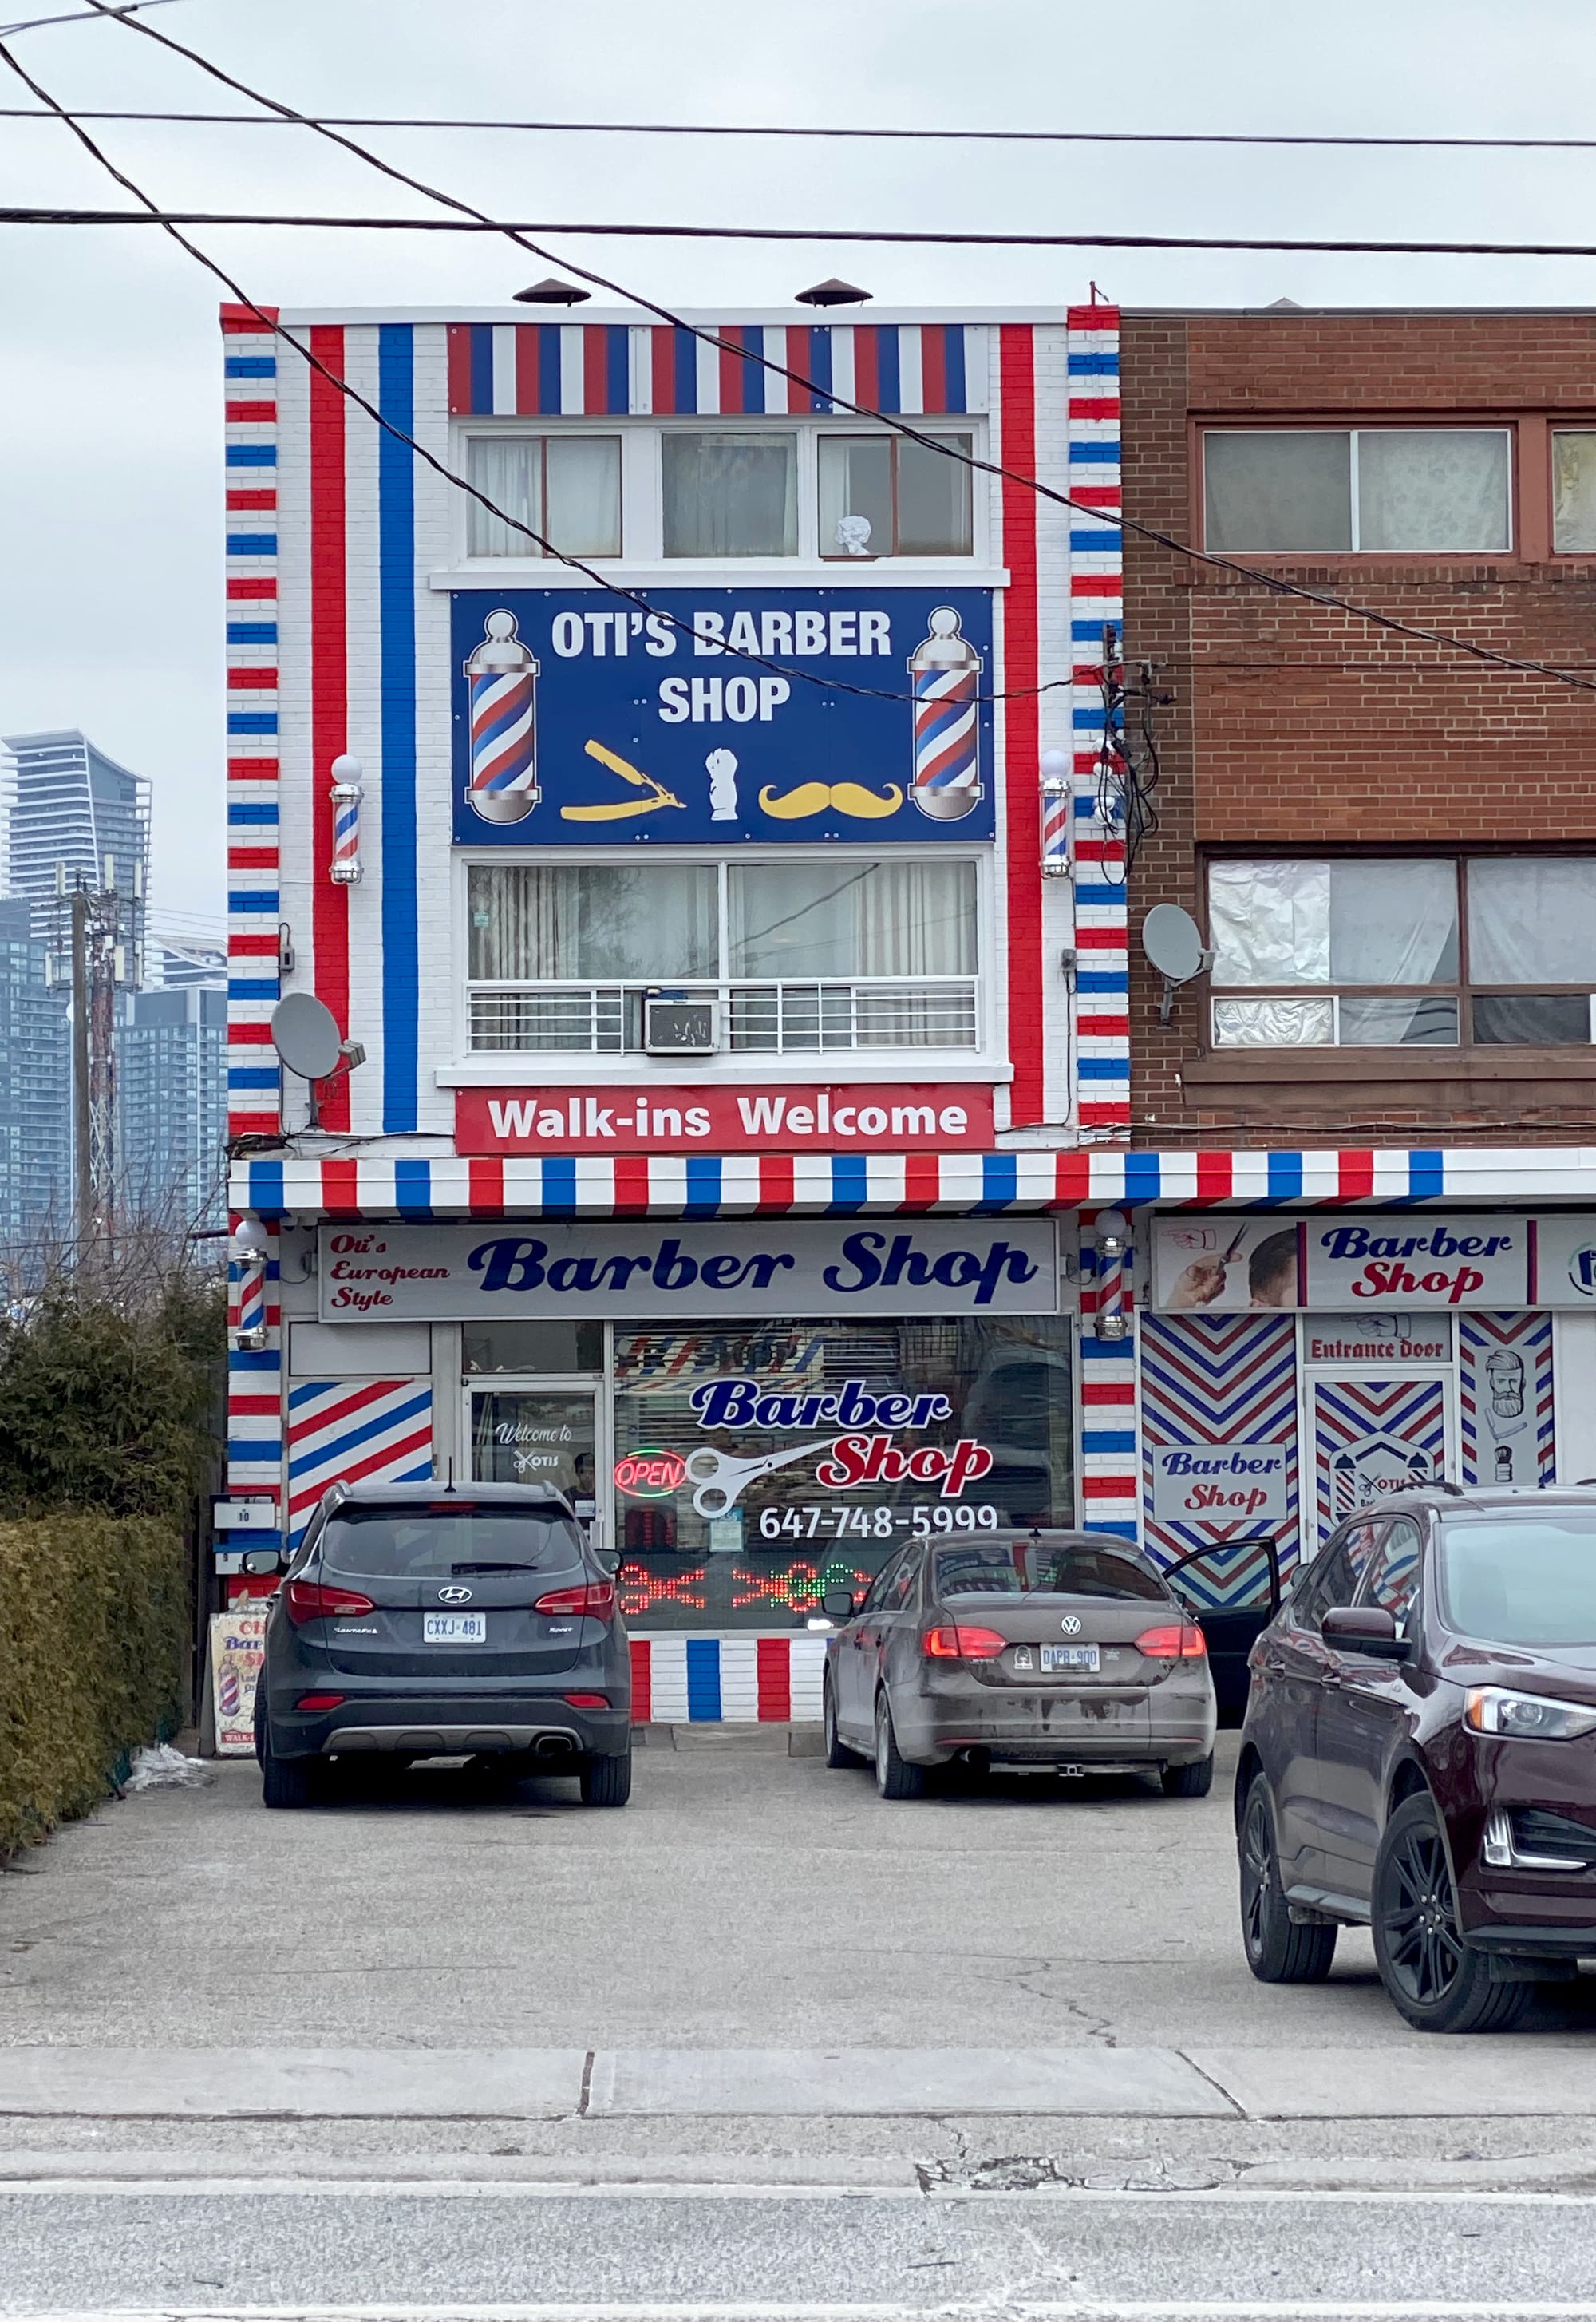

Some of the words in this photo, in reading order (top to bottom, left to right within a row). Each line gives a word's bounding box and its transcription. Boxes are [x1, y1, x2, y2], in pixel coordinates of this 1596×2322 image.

[552, 611, 676, 657] OTI'S
[693, 611, 892, 656] BARBER
[658, 677, 790, 722] SHOP
[488, 1097, 711, 1138] Walk-ins
[737, 1094, 968, 1137] Welcome
[1321, 1227, 1513, 1259] Barber
[330, 1260, 451, 1285] European
[467, 1237, 794, 1292] Barber
[822, 1231, 1040, 1305] Shop
[1351, 1262, 1484, 1303] Shop
[331, 1287, 394, 1311] Style
[1311, 1339, 1394, 1359] Entrance
[1400, 1336, 1444, 1358] Door
[689, 1379, 953, 1430] Barber
[495, 1422, 558, 1444] Welcome
[559, 1424, 572, 1442] to
[531, 1456, 559, 1466] OTIS
[616, 1462, 682, 1486] OPEN
[816, 1434, 994, 1498] Shop
[1162, 1452, 1282, 1476] Barber
[1184, 1484, 1268, 1514] Shop
[239, 1513, 250, 1522] 10
[759, 1505, 998, 1540] 647-748-5999
[223, 1553, 228, 1562] 9
